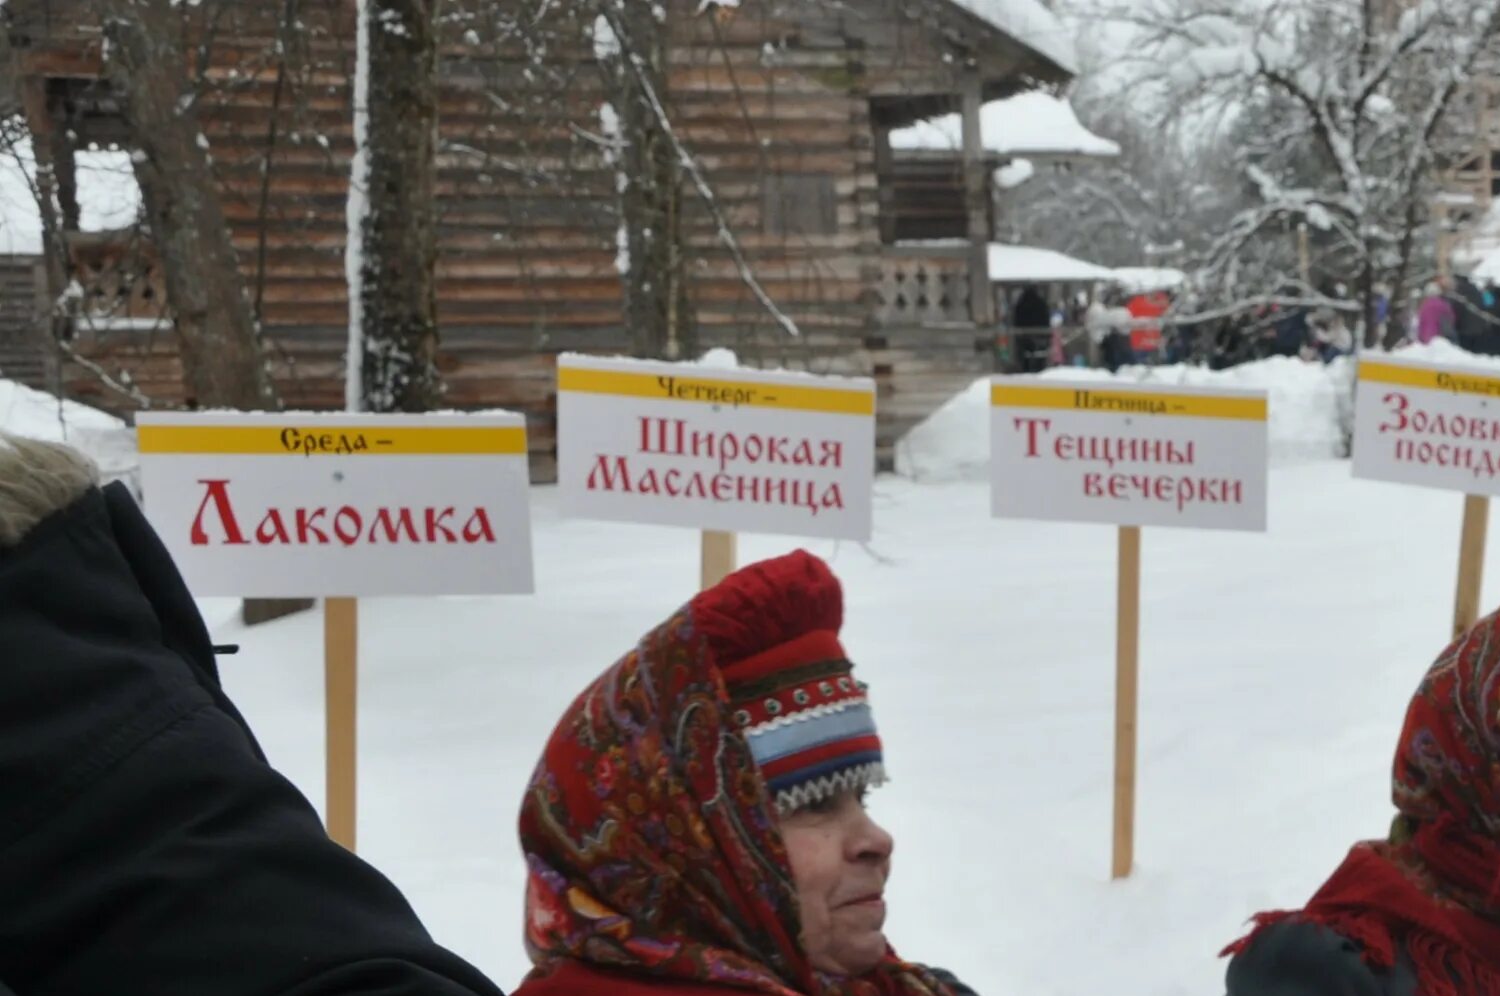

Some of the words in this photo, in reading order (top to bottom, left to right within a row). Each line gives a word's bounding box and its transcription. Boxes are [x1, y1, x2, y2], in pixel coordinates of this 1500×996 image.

[657, 376, 757, 408] Четверг
[1073, 389, 1167, 416] Пятница
[279, 427, 368, 457] Среда
[637, 416, 844, 473] Широкая
[1013, 416, 1196, 467] Тещины
[586, 453, 846, 516] Масленица
[1082, 472, 1244, 513] вечерки
[190, 479, 497, 547] Лакомка
